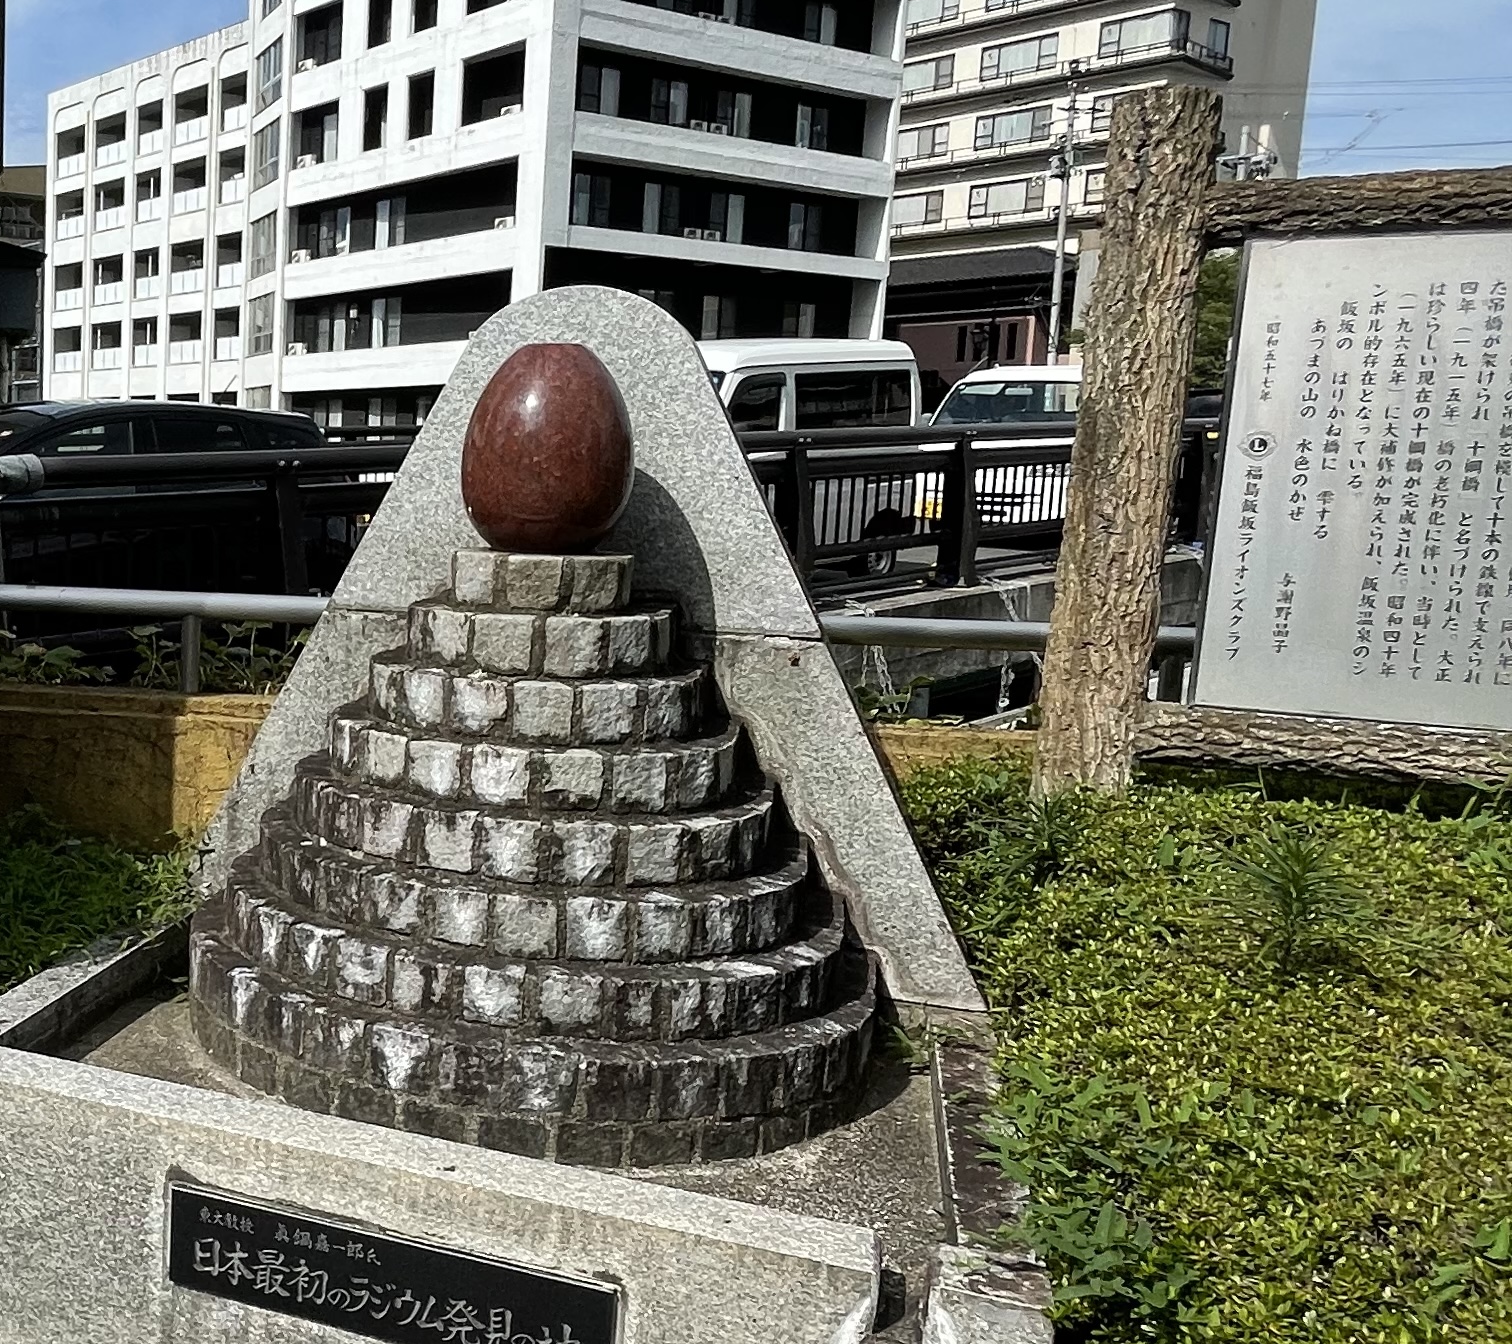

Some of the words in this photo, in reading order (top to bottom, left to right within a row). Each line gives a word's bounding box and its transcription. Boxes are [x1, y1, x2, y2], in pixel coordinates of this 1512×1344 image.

[1259, 321, 1282, 402] 昭和五十七年
[1300, 318, 1327, 419] あづまの山の
